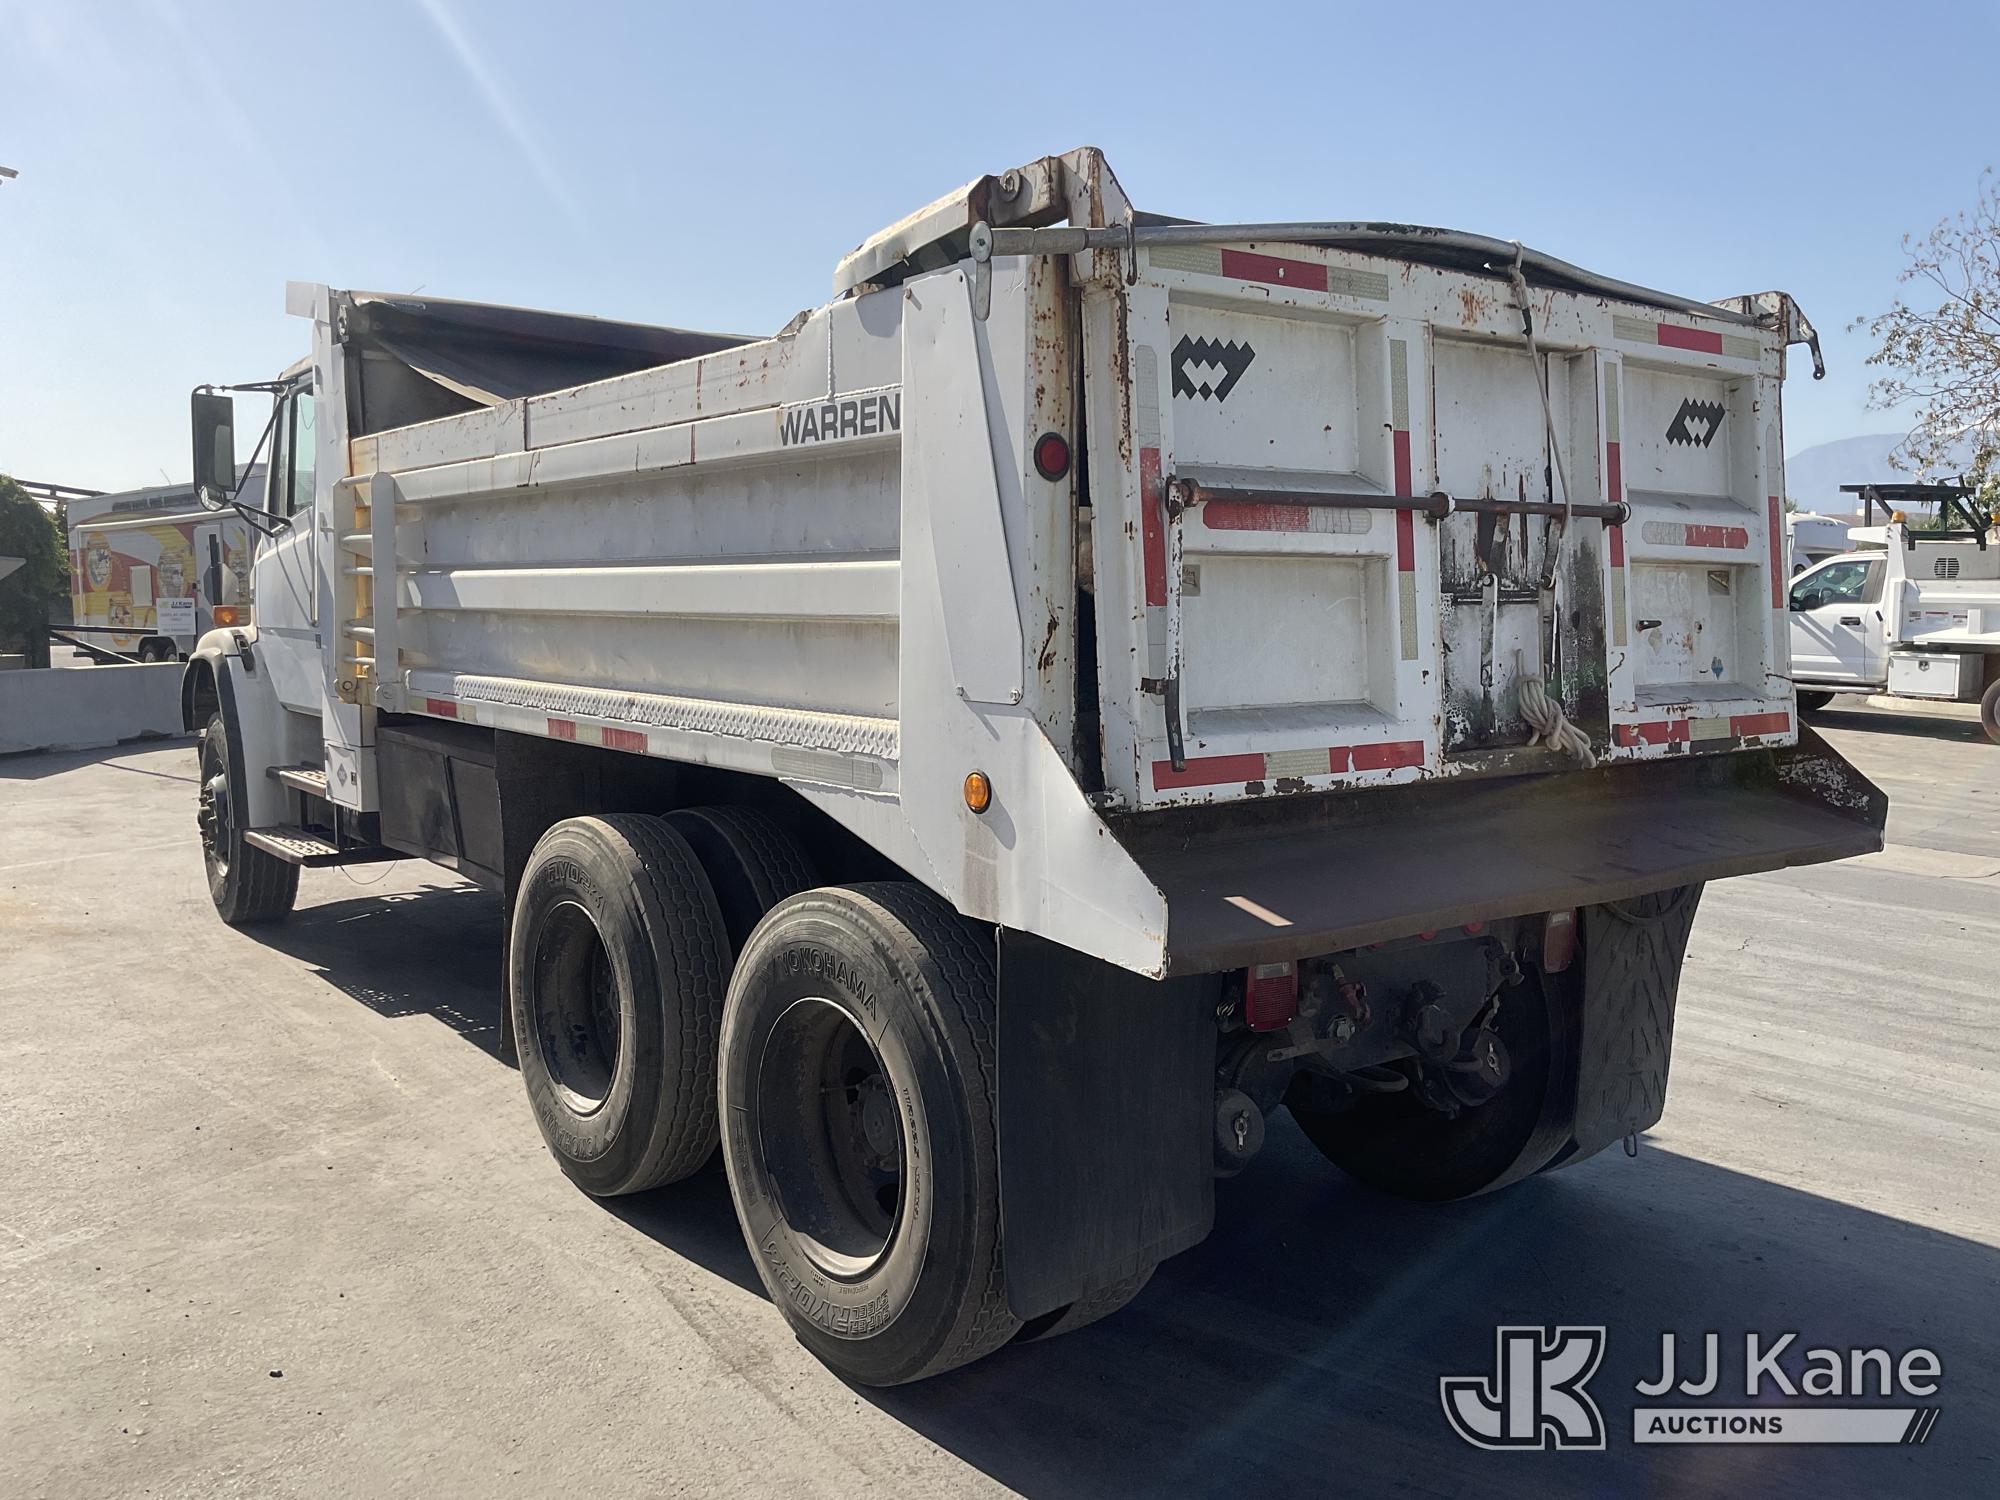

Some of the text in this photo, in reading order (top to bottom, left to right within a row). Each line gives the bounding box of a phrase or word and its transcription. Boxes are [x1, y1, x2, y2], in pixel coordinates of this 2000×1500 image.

[780, 393, 901, 446] WARREN
[776, 947, 877, 1022] YOKOHAMA
[850, 1304, 891, 1334] SUPER
[851, 1288, 888, 1320] STEEL
